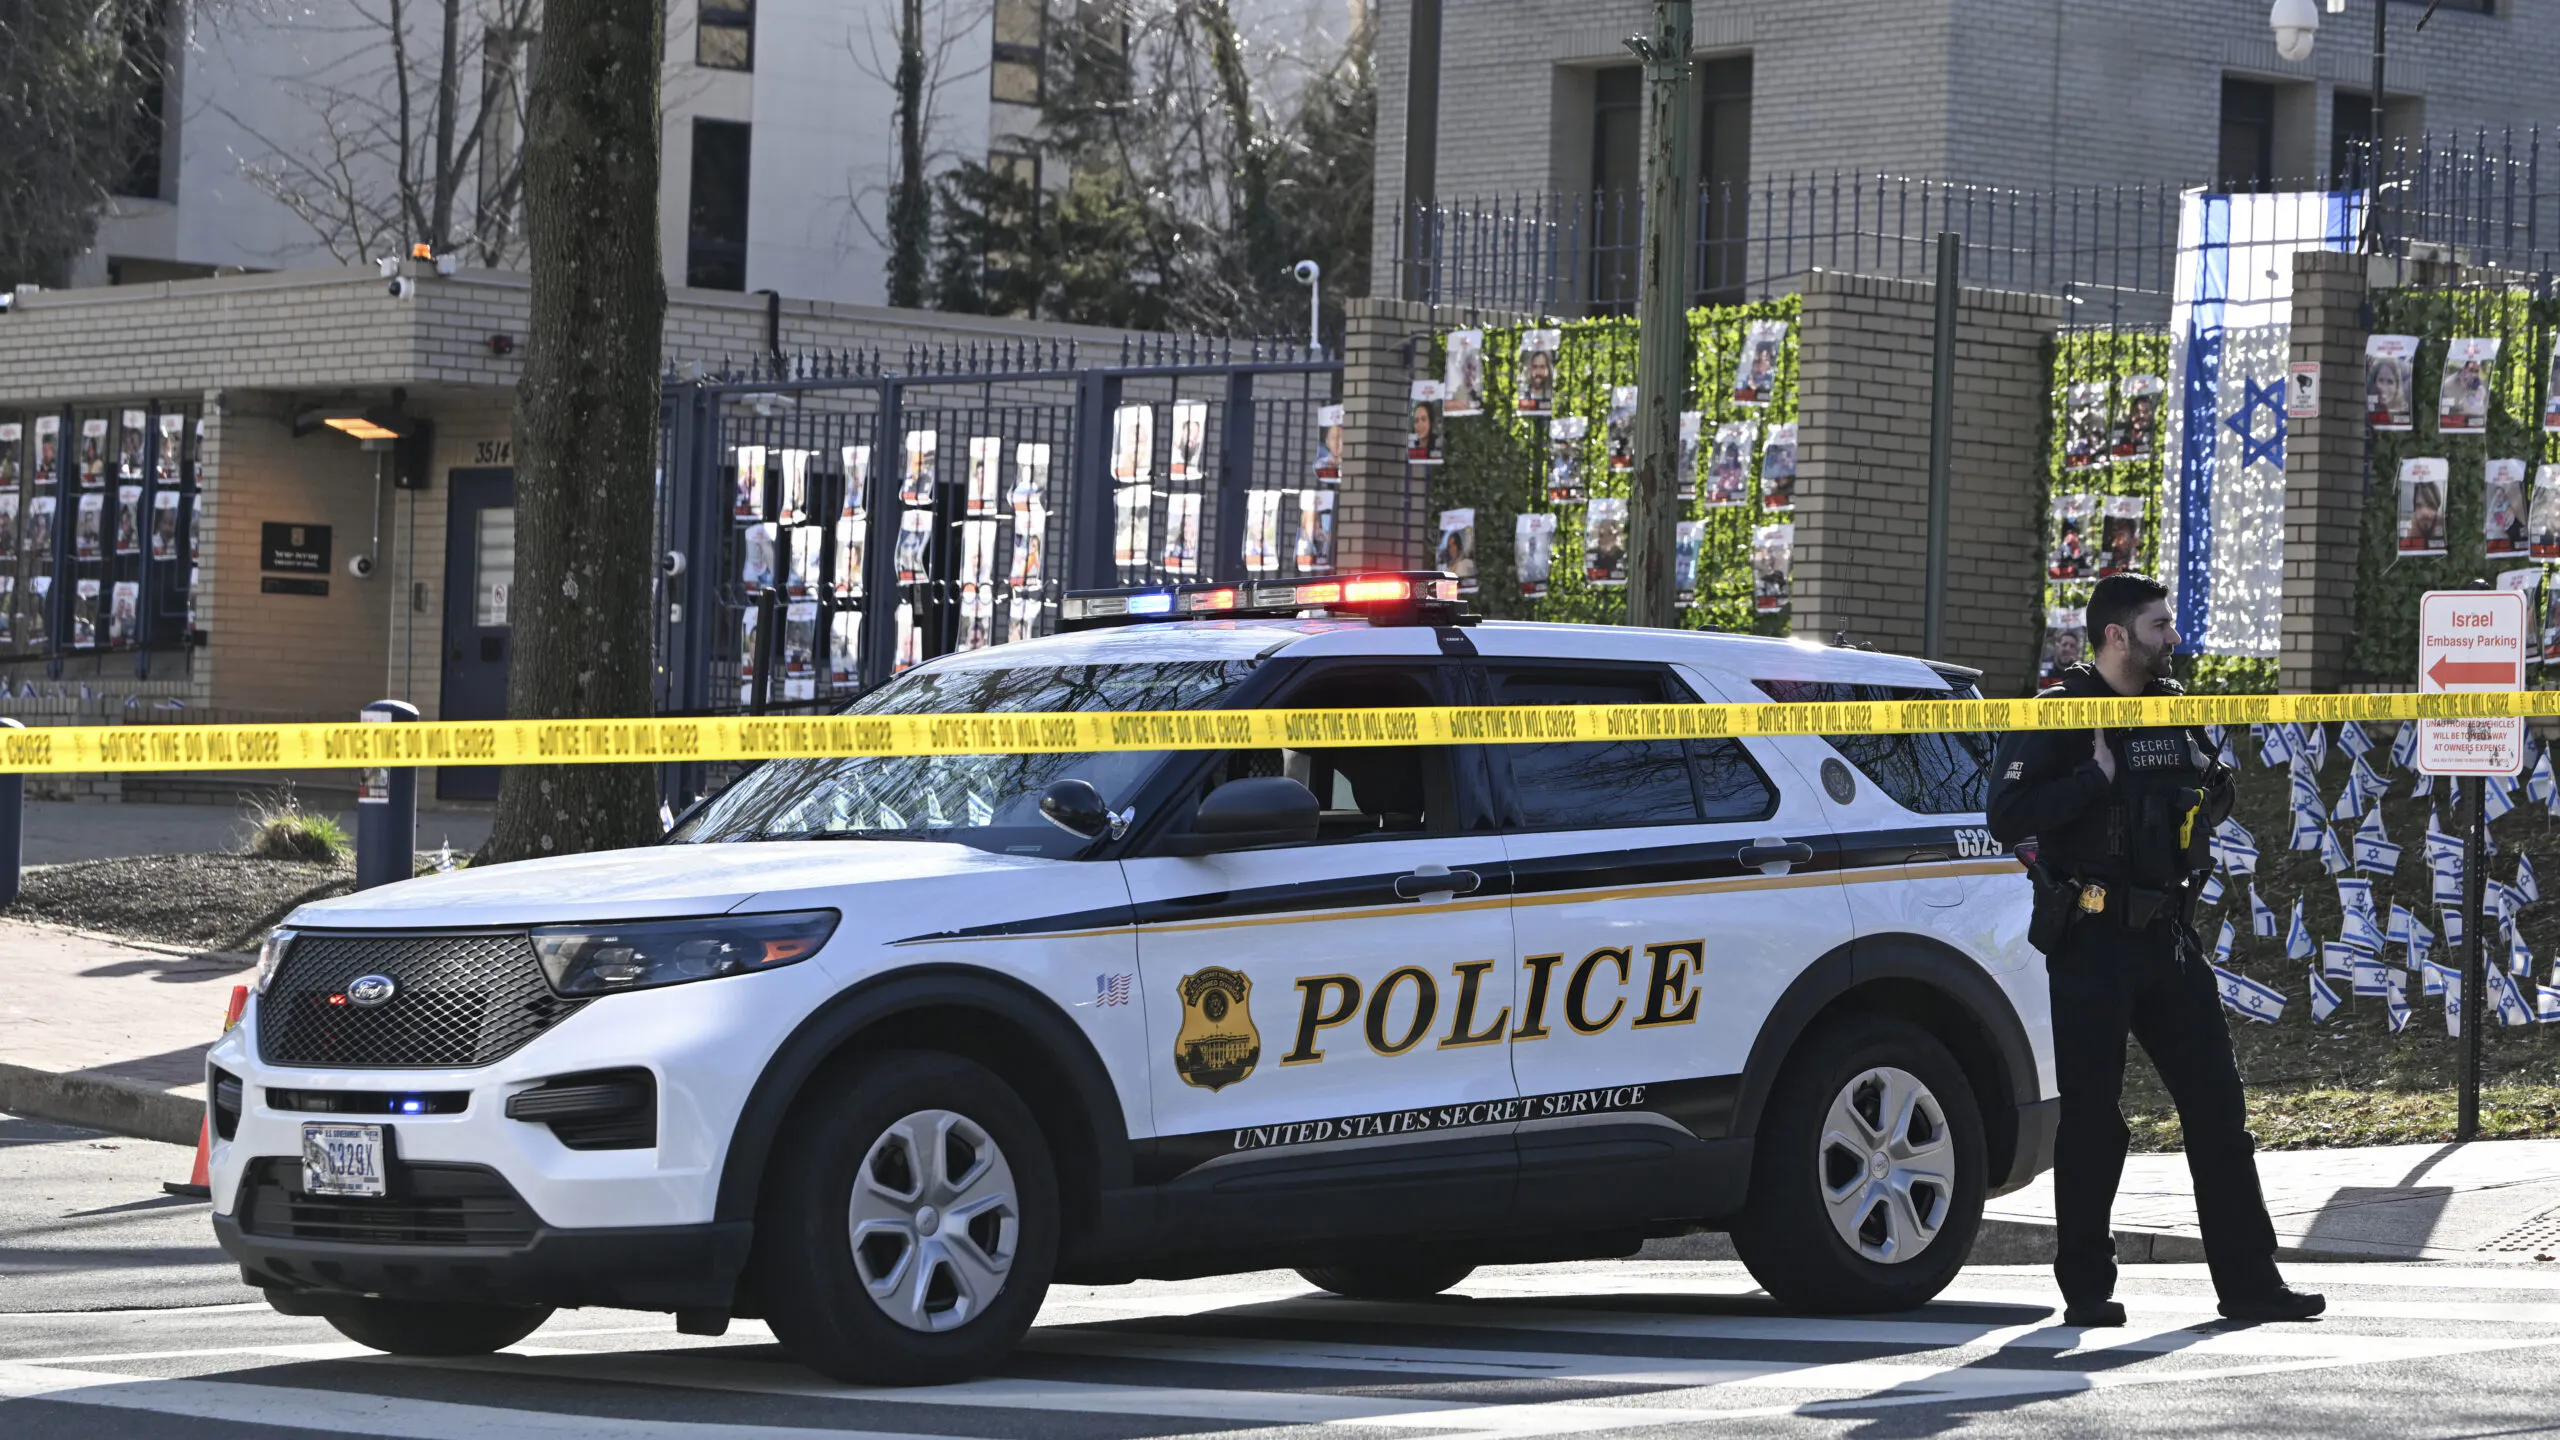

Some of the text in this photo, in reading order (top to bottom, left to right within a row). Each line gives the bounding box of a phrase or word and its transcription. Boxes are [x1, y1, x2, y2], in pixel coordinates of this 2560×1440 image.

[475, 440, 510, 463] 3514
[2452, 611, 2494, 627] Israel
[2427, 635, 2517, 649] Embassy Parking
[2426, 720, 2515, 728] UNAUTHORIZED VEHICLES
[2433, 732, 2507, 740] WILL BE TOWED AWAY
[2132, 740, 2175, 752] SECRET
[2444, 744, 2474, 752] OWNERS
[2476, 744, 2506, 752] EXPENSE
[2132, 754, 2180, 767] SERVICE
[1279, 939, 1706, 1067] POLICE
[1233, 1085, 1647, 1150] UNITED STATES SECRET SERVICE
